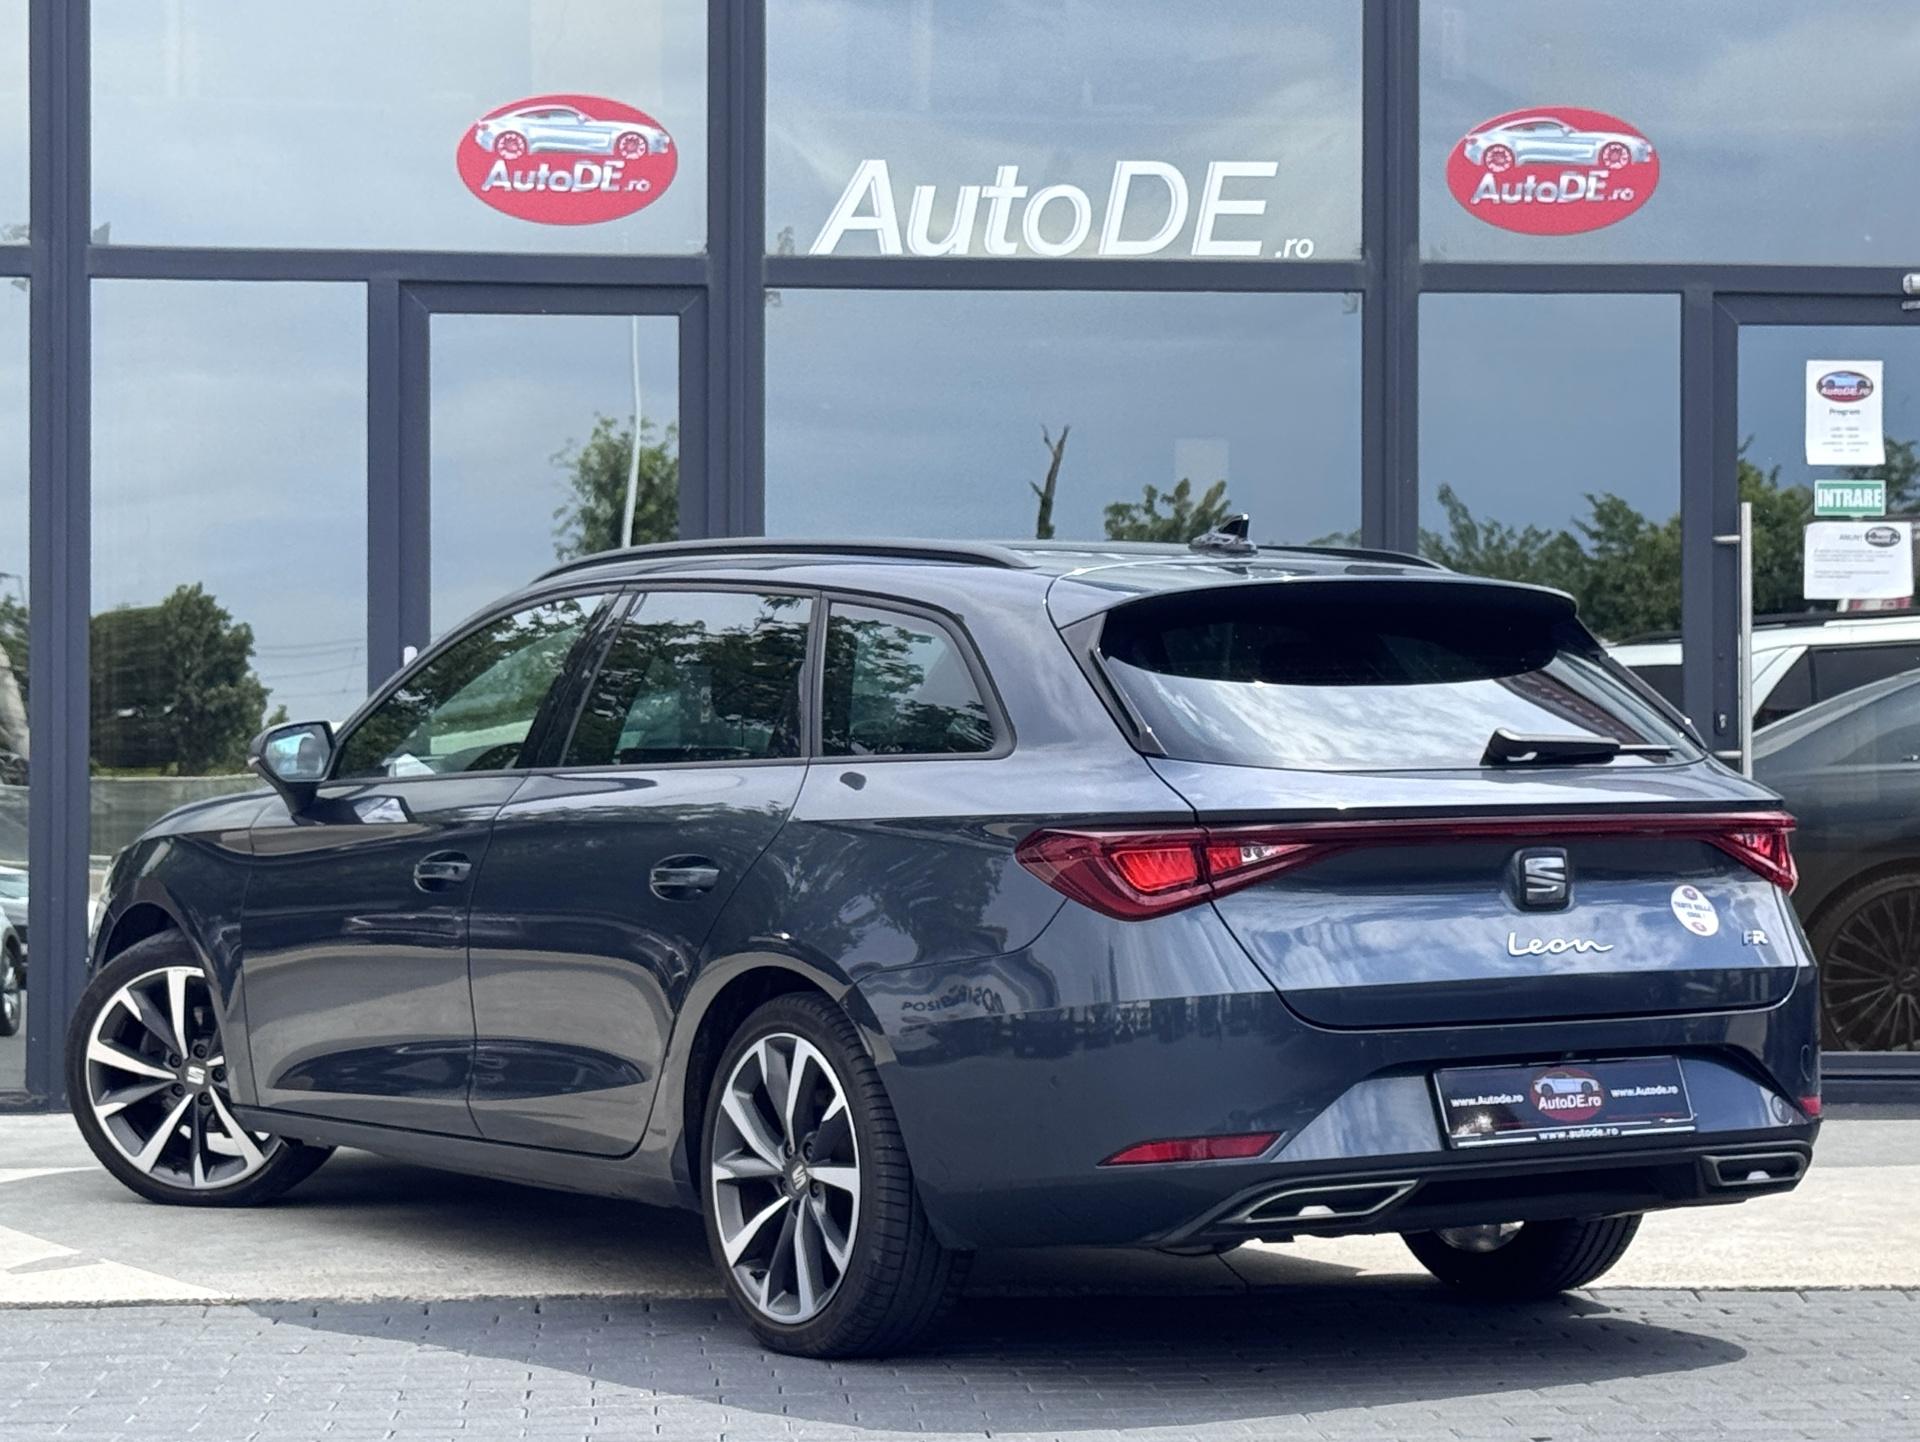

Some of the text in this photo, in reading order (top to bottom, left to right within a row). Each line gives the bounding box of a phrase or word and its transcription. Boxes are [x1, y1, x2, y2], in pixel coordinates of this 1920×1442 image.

[1817, 488, 1882, 507] INTRARE
[1507, 932, 1614, 957] Leon
[1741, 930, 1769, 946] FR
[1610, 1084, 1679, 1099] www.Autode.ro
[1450, 1093, 1524, 1108] www.Autode.ro
[1538, 1094, 1602, 1112] AutoDE.ro
[1538, 1127, 1619, 1141] www.autode.ro
